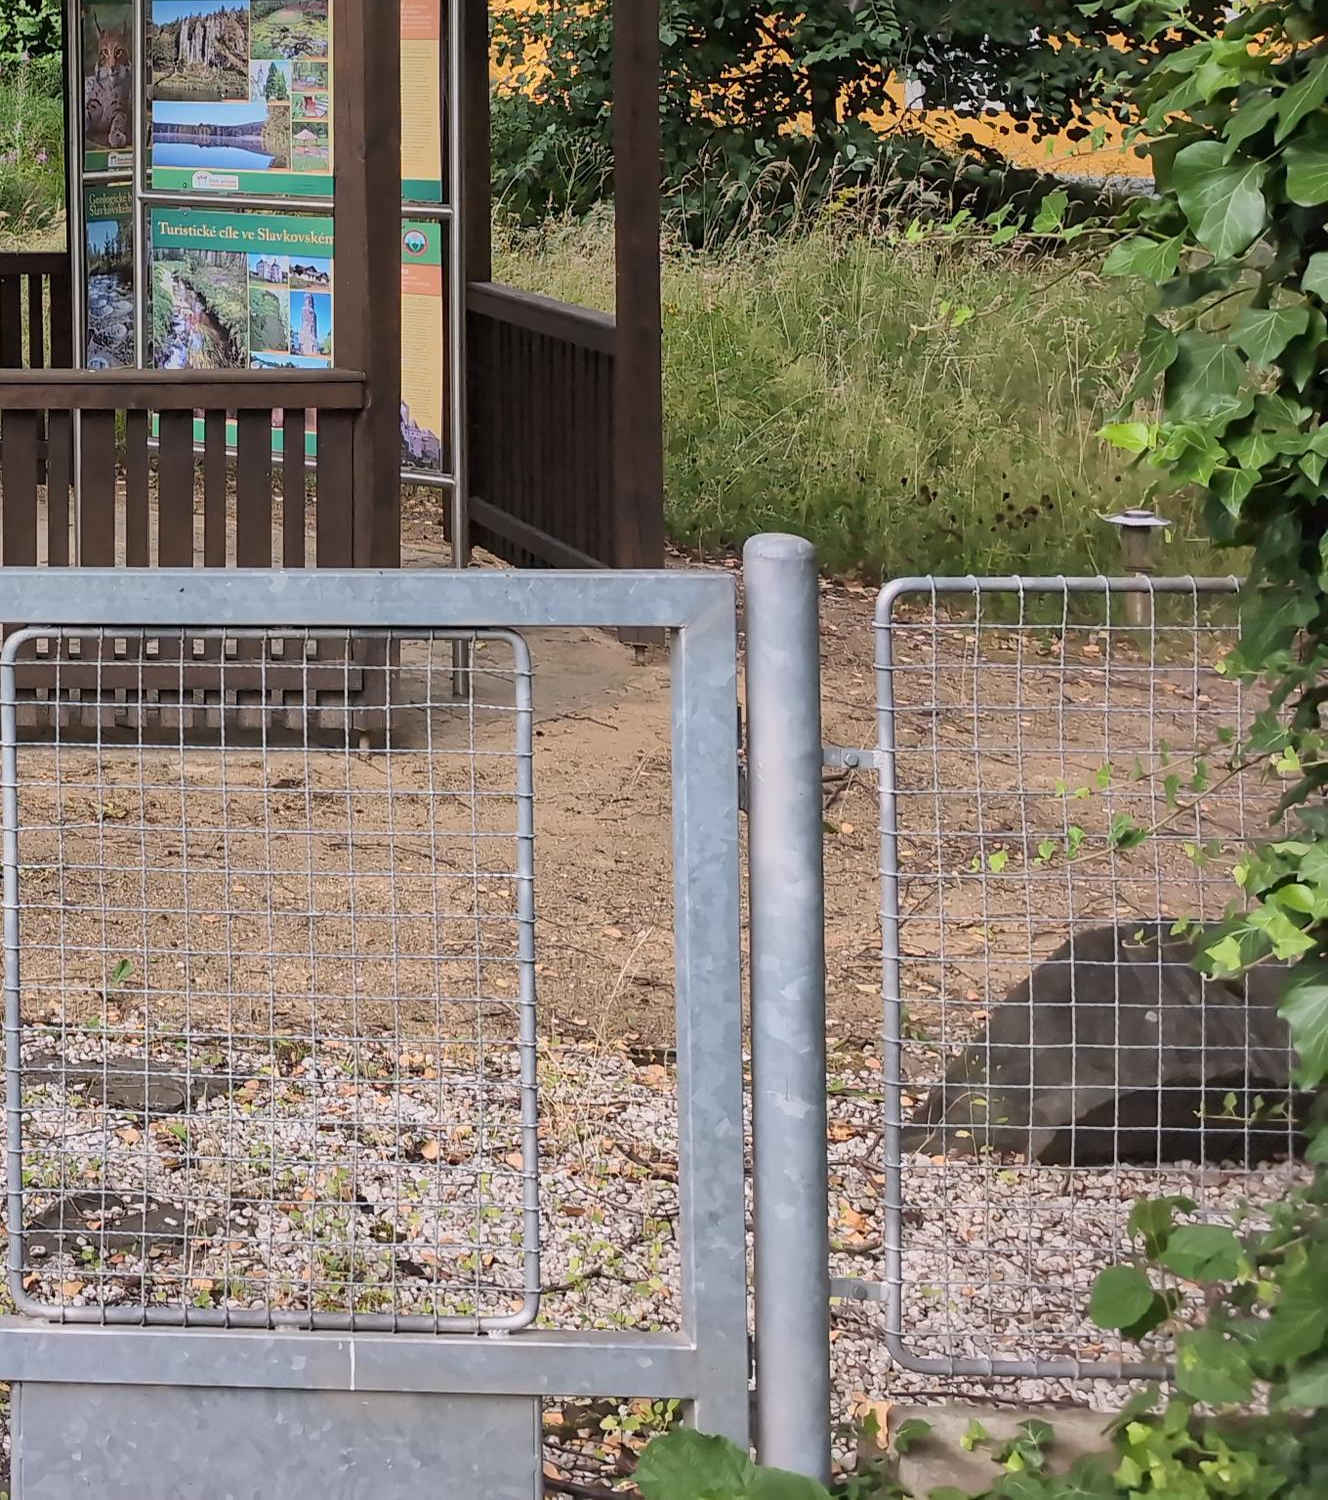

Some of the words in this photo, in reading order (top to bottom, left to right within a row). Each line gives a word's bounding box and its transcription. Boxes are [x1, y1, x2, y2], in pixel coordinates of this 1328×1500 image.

[158, 221, 216, 238] Turistické
[219, 226, 240, 239] cíle
[242, 231, 255, 240] ve
